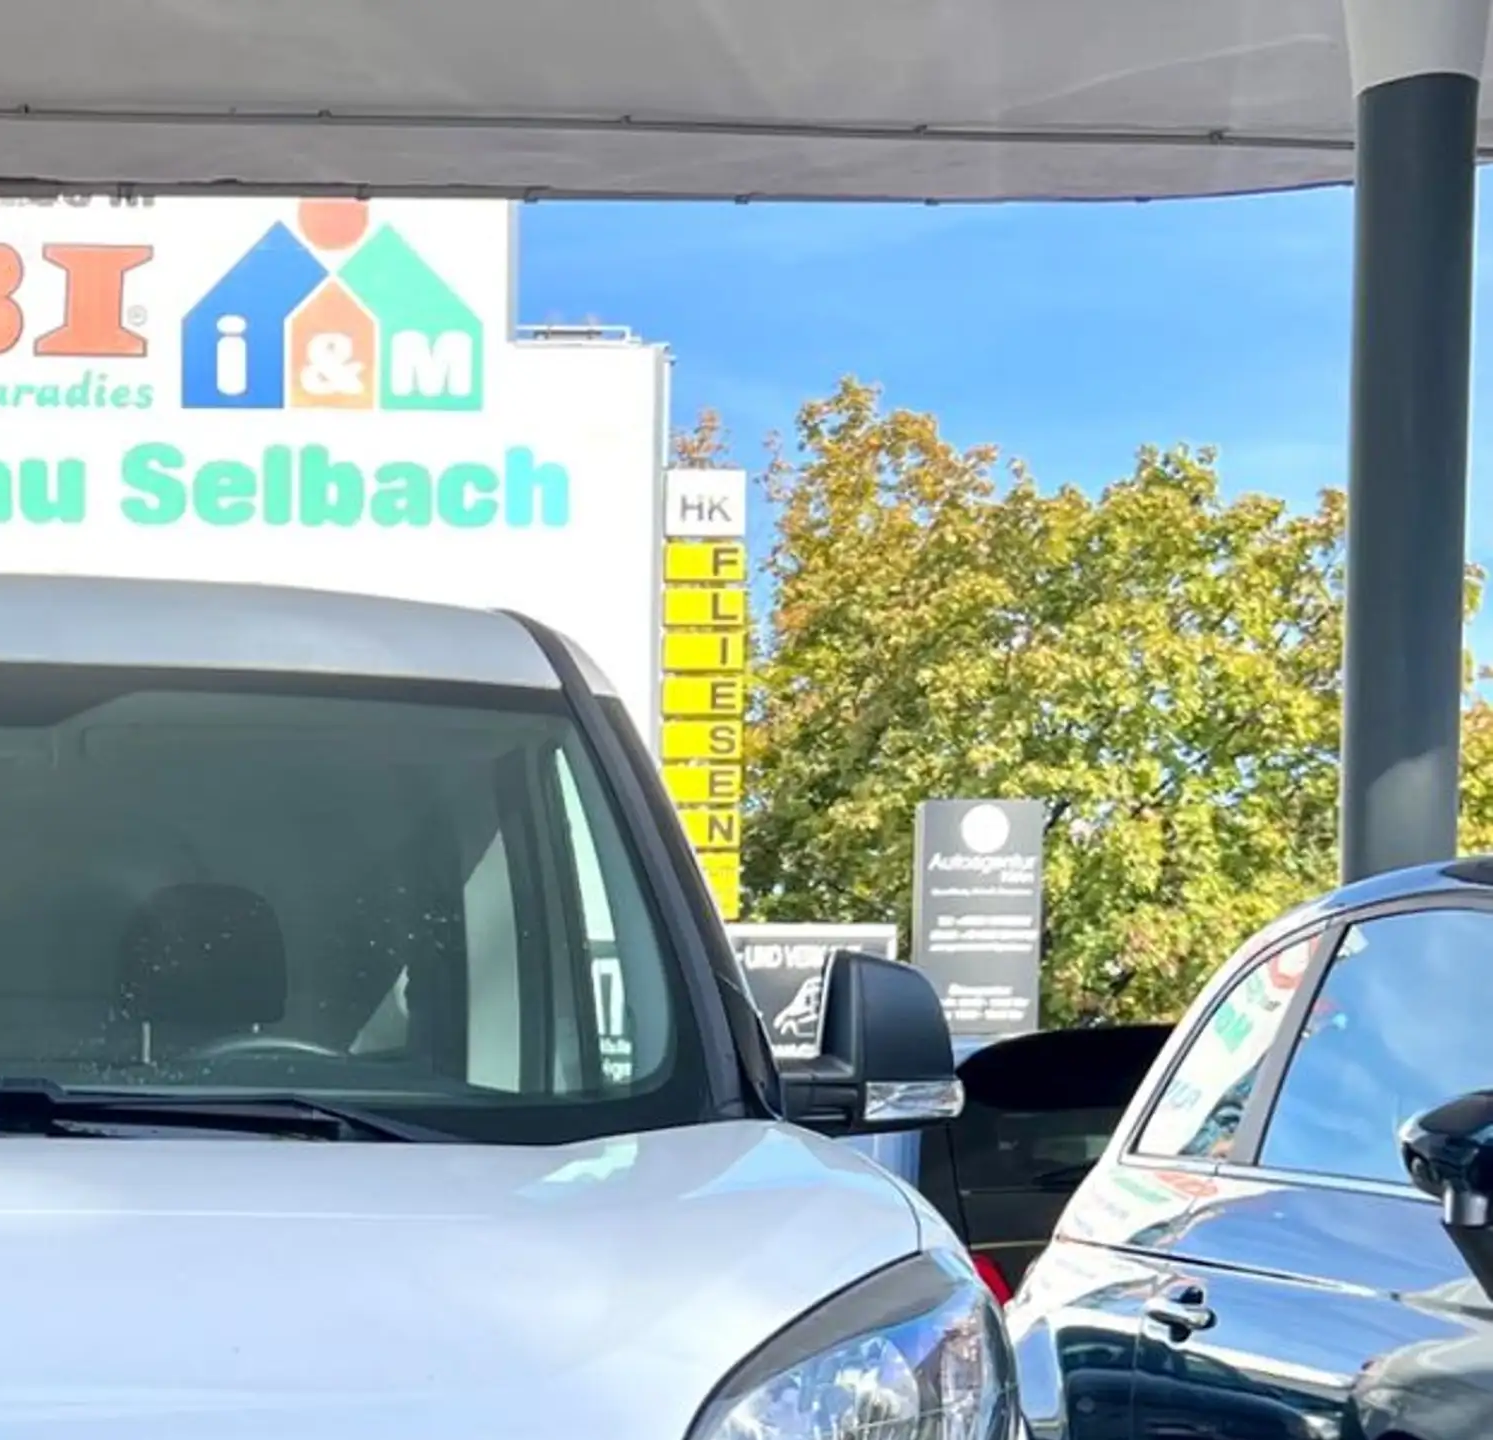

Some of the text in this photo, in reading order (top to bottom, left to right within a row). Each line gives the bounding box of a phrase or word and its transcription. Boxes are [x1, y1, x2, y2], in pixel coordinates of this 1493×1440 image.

[119, 442, 573, 530] Selbach
[679, 494, 732, 523] HK
[707, 547, 739, 844] FLIESEN
